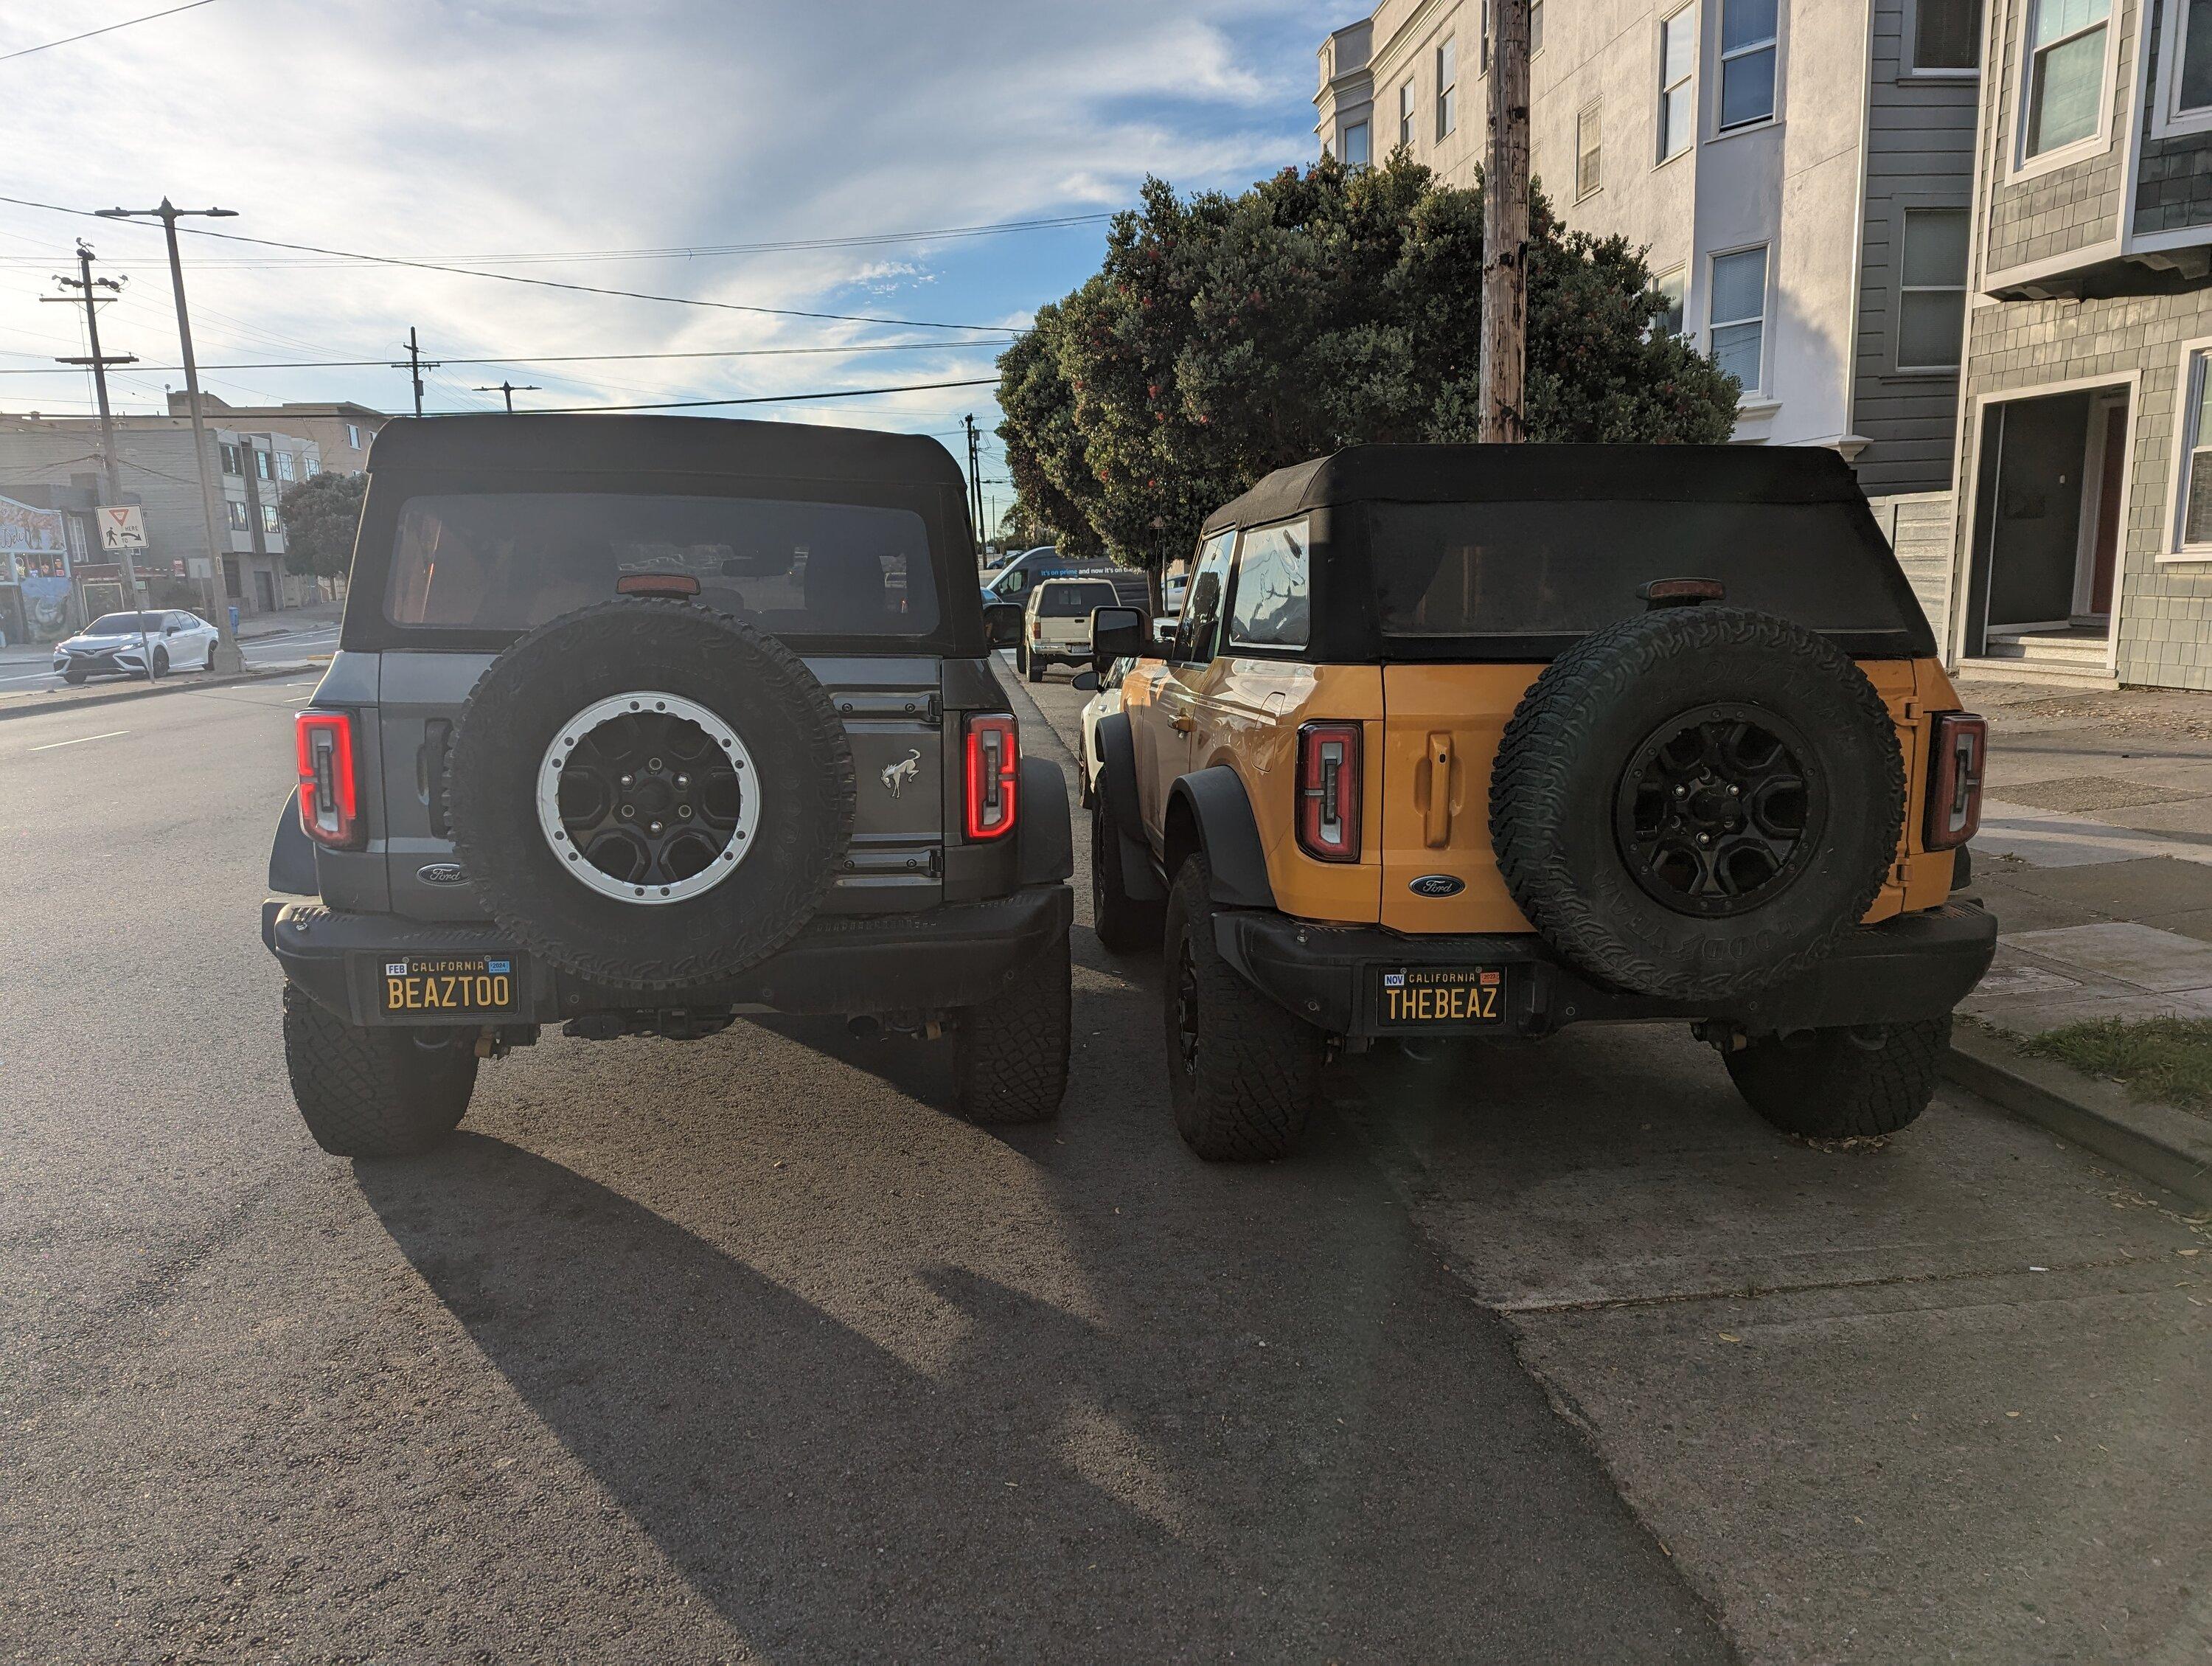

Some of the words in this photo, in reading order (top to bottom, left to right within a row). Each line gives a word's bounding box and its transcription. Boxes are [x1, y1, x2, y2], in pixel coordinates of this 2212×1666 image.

[430, 868, 461, 881] Ford
[1422, 880, 1453, 893] Ford
[389, 965, 406, 974] FEB
[412, 961, 484, 972] CALIFORNIA
[1386, 975, 1403, 985] NOV
[1409, 973, 1475, 983] CALIFORNIA
[387, 976, 509, 1009] BEAZTOO
[1386, 988, 1497, 1020] THEBEAZ
